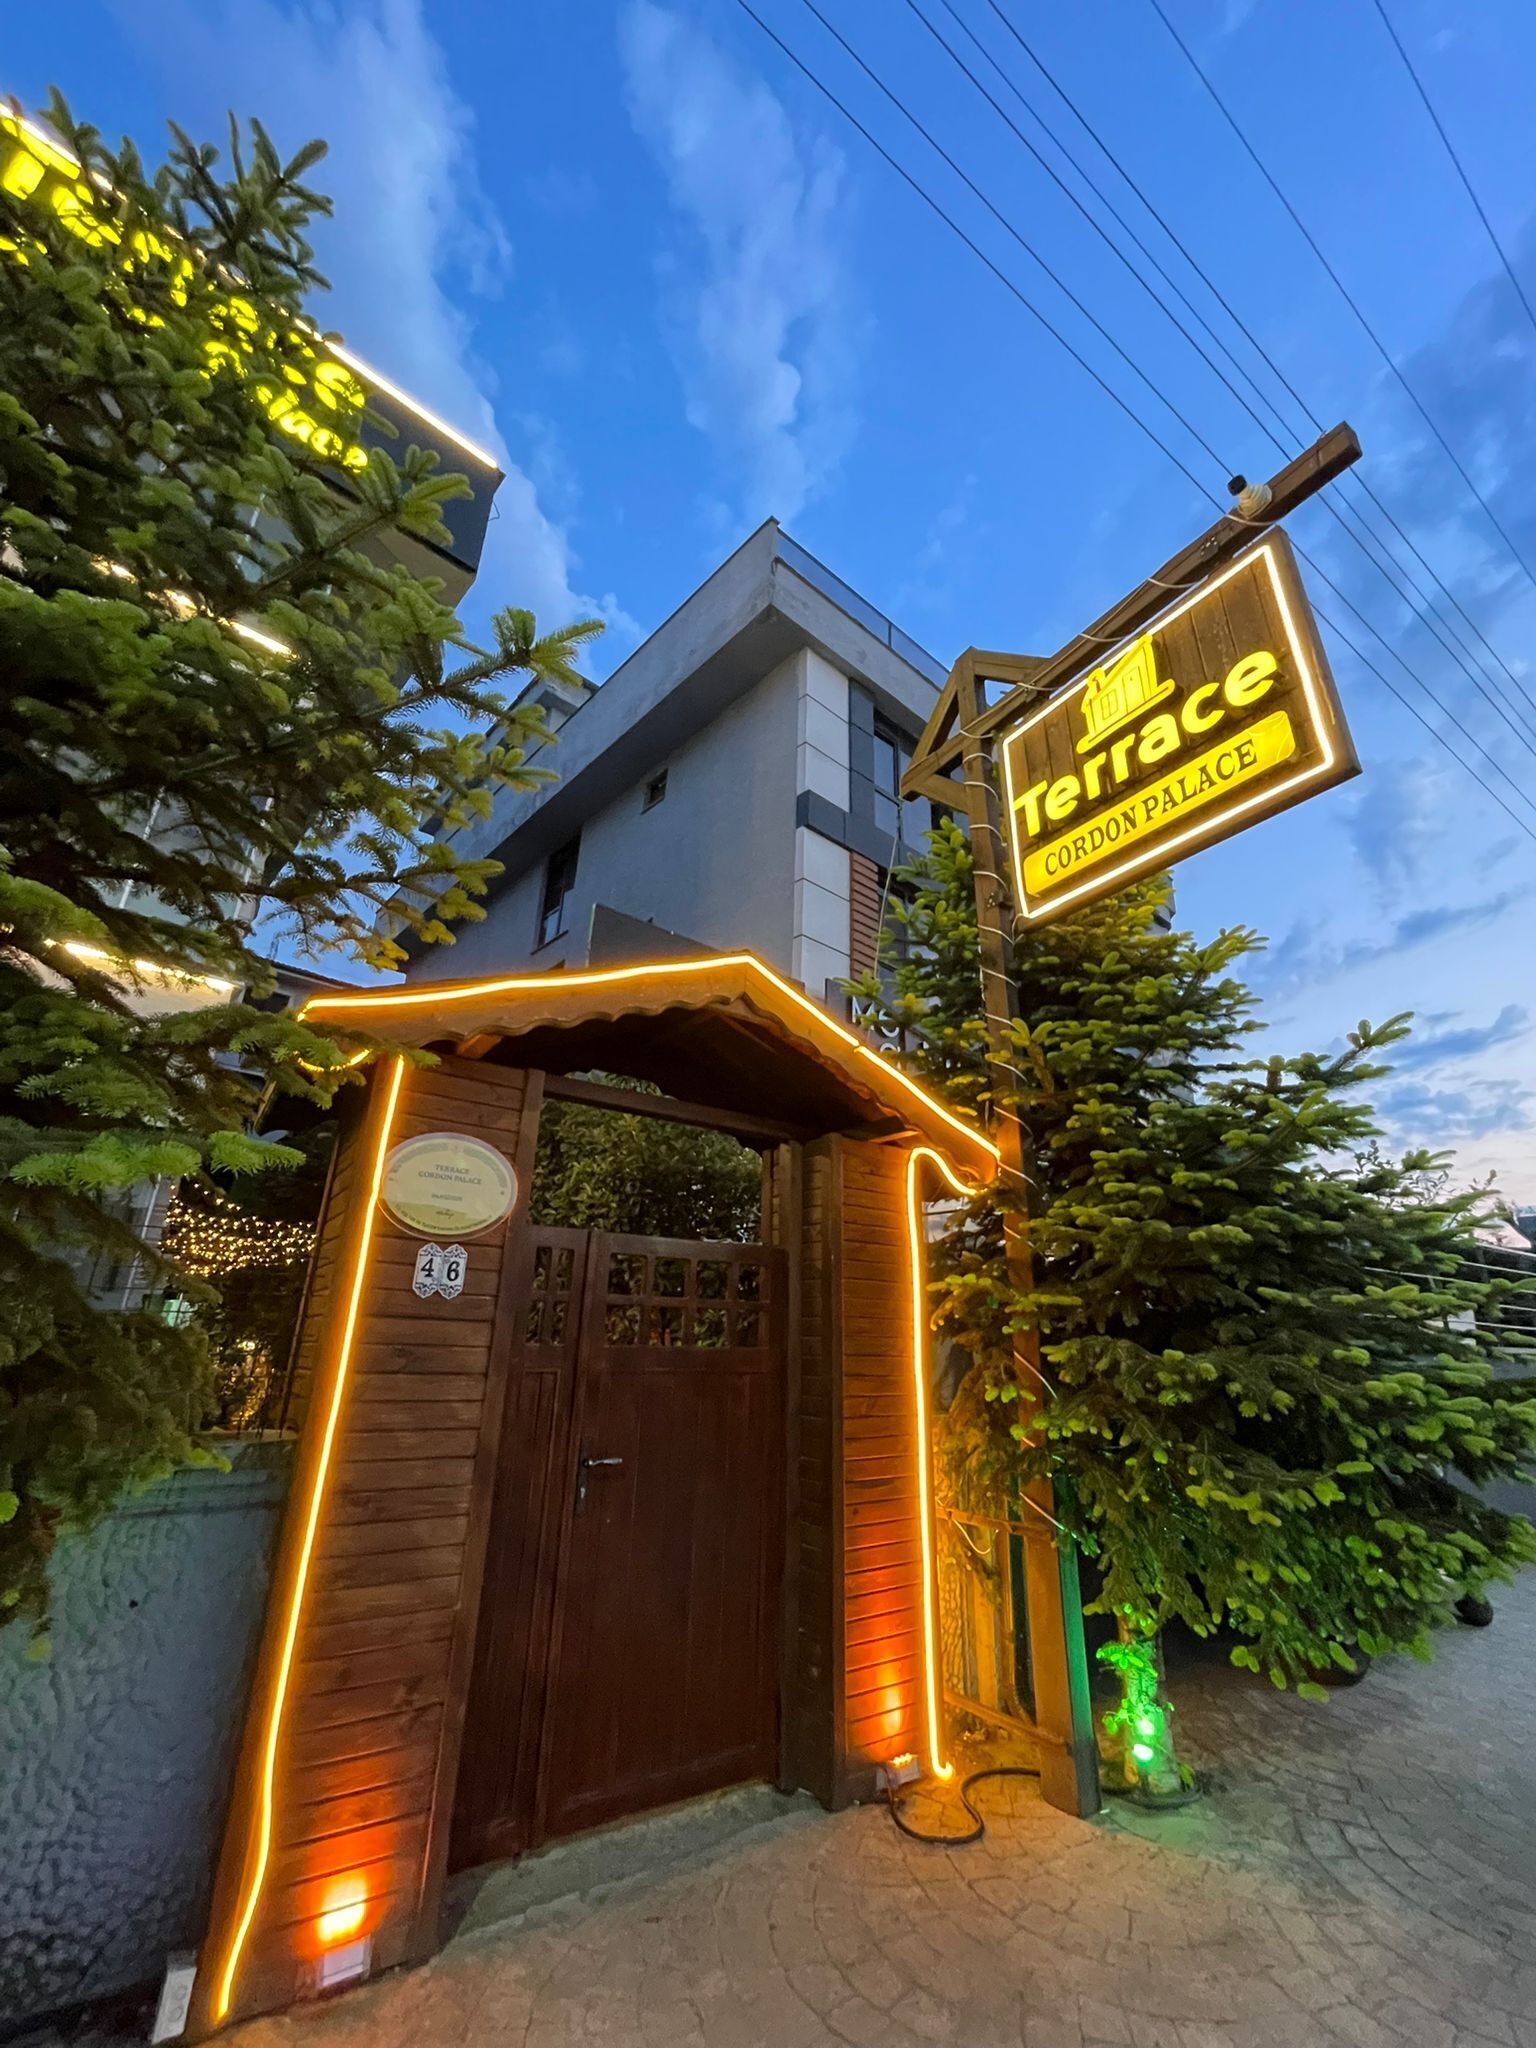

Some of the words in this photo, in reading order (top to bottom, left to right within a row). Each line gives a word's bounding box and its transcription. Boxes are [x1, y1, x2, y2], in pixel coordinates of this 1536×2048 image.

[1014, 650, 1278, 837] Terrace
[1044, 806, 1138, 876] CORDON
[1144, 738, 1258, 823] PALACE
[418, 1170, 453, 1182] CORDON
[454, 1173, 482, 1185] PALACE
[435, 1164, 470, 1175] TERRACE
